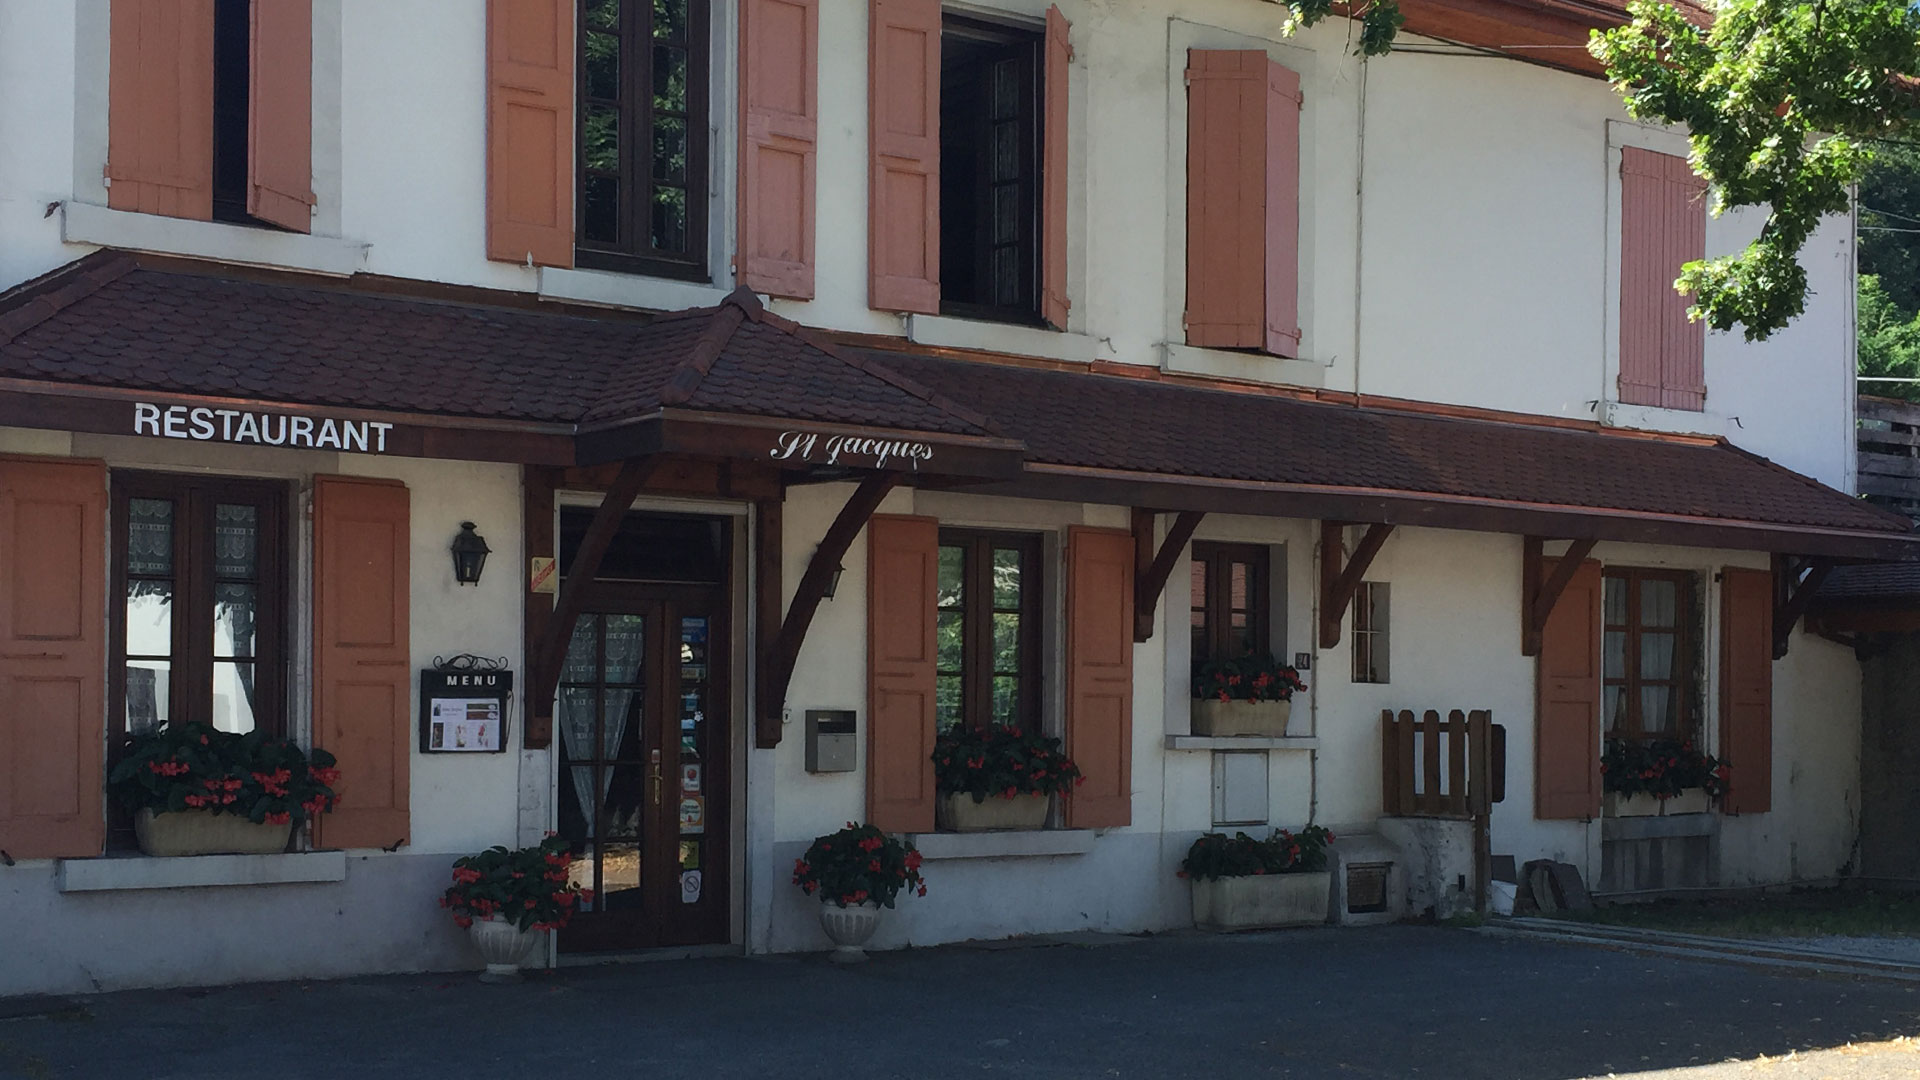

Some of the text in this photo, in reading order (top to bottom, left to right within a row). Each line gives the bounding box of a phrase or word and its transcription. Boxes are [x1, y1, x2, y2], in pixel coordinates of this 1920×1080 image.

[134, 402, 393, 453] RESTAURANT
[769, 431, 934, 471] St Jacques
[446, 675, 496, 687] MENU
